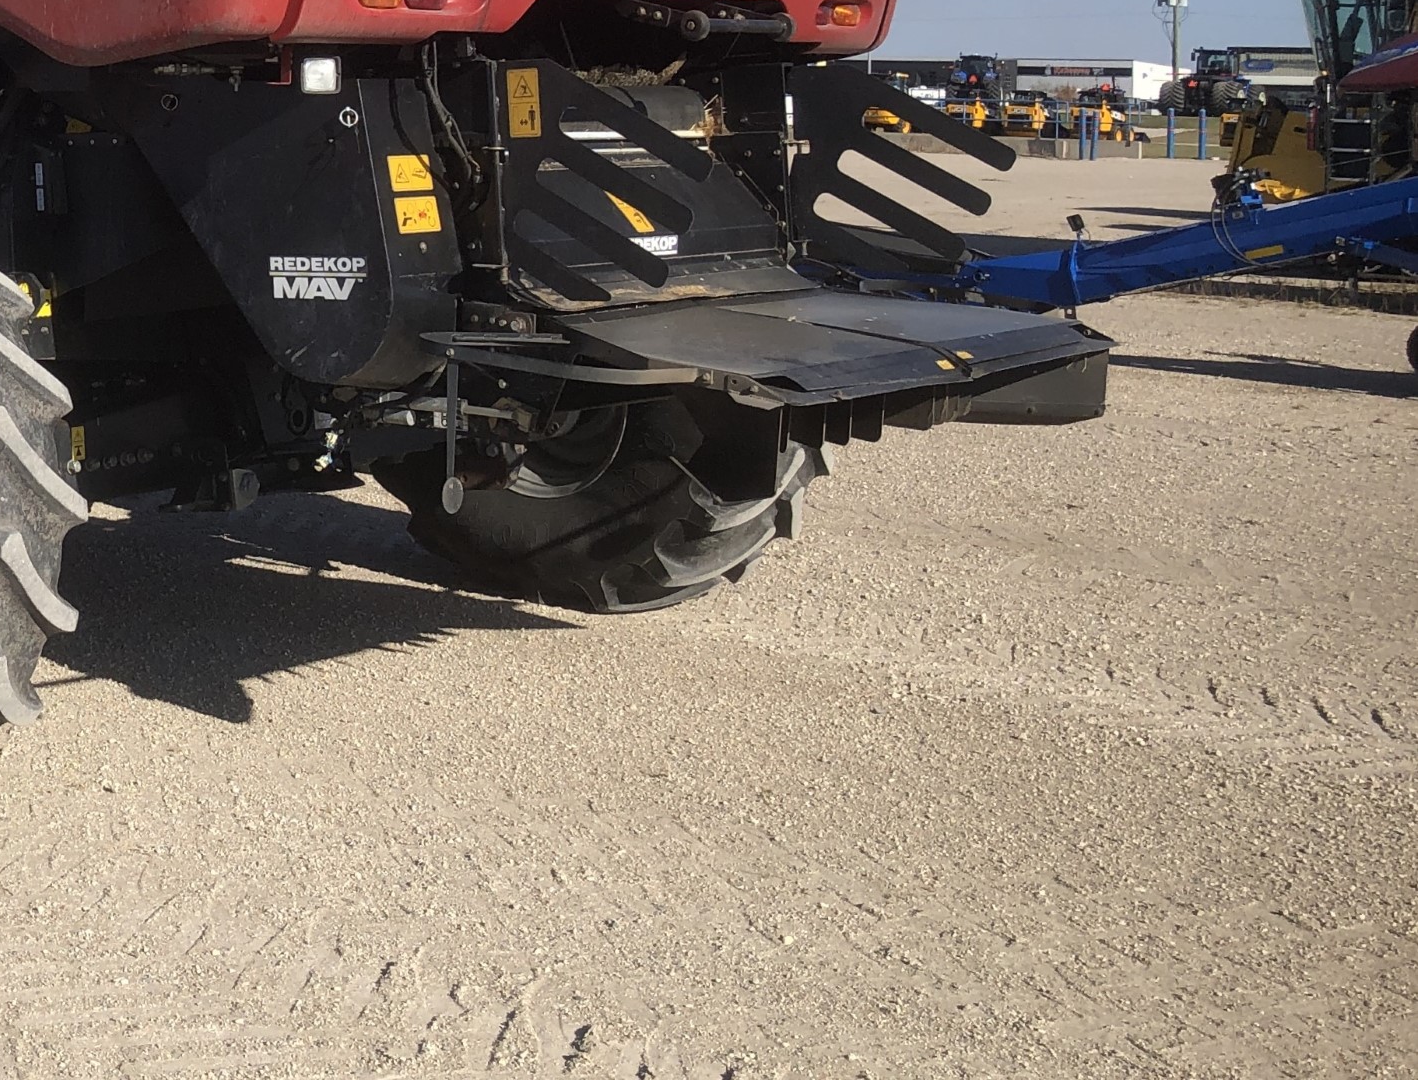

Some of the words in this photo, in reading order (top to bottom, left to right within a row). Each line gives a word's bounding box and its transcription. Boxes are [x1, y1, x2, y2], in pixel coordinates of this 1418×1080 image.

[633, 236, 677, 251] DEKOP
[269, 256, 366, 272] REDEKOP
[273, 276, 356, 301] MAV
